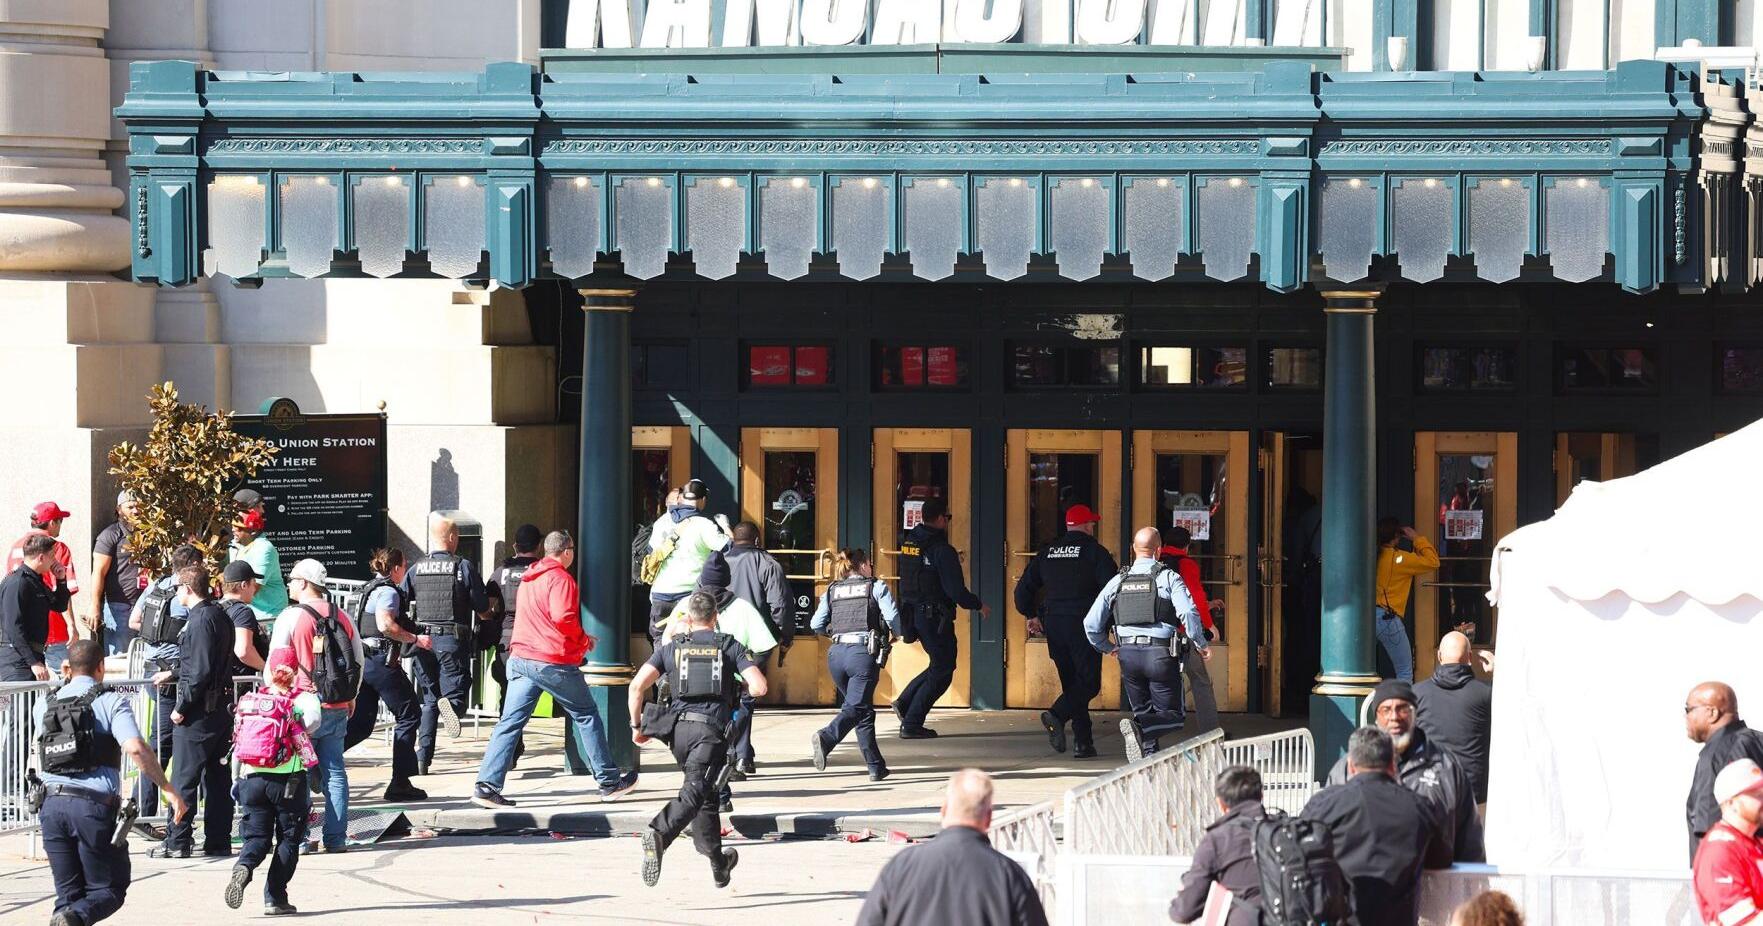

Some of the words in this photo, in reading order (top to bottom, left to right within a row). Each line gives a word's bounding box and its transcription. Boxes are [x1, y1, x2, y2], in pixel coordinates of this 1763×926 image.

[279, 438, 319, 448] UNION
[322, 437, 376, 447] STATION
[283, 457, 317, 466] HERE
[1049, 546, 1080, 554] POLICE
[416, 562, 440, 574] POLICE
[441, 561, 454, 573] K-9
[834, 584, 866, 599] POLICE
[1121, 584, 1150, 592] POLICE
